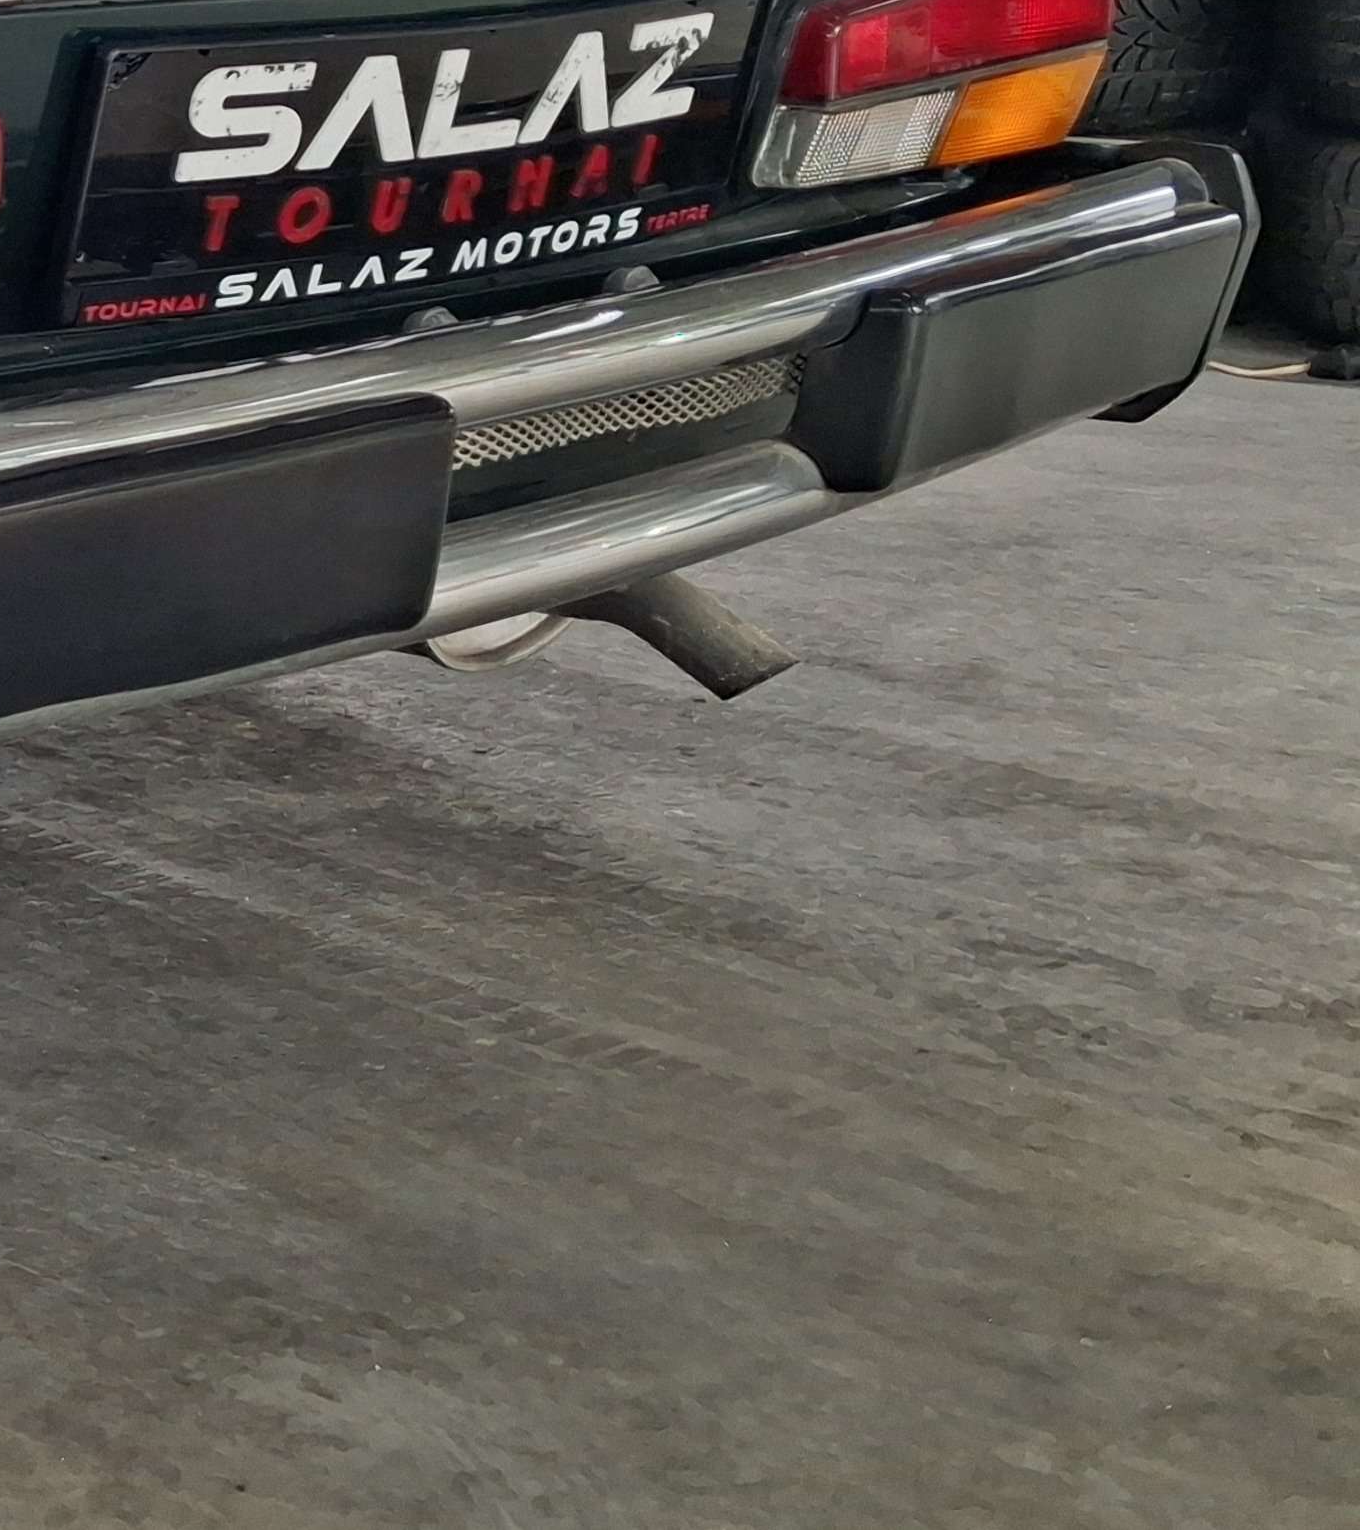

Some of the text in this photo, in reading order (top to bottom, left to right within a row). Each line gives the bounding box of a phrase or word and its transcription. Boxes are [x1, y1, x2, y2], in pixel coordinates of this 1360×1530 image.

[174, 12, 714, 183] SALAZ
[204, 134, 662, 252] TOURNAI
[83, 293, 207, 322] TOURNAI
[214, 246, 435, 309] SALAZ
[449, 206, 643, 274] MOTORS
